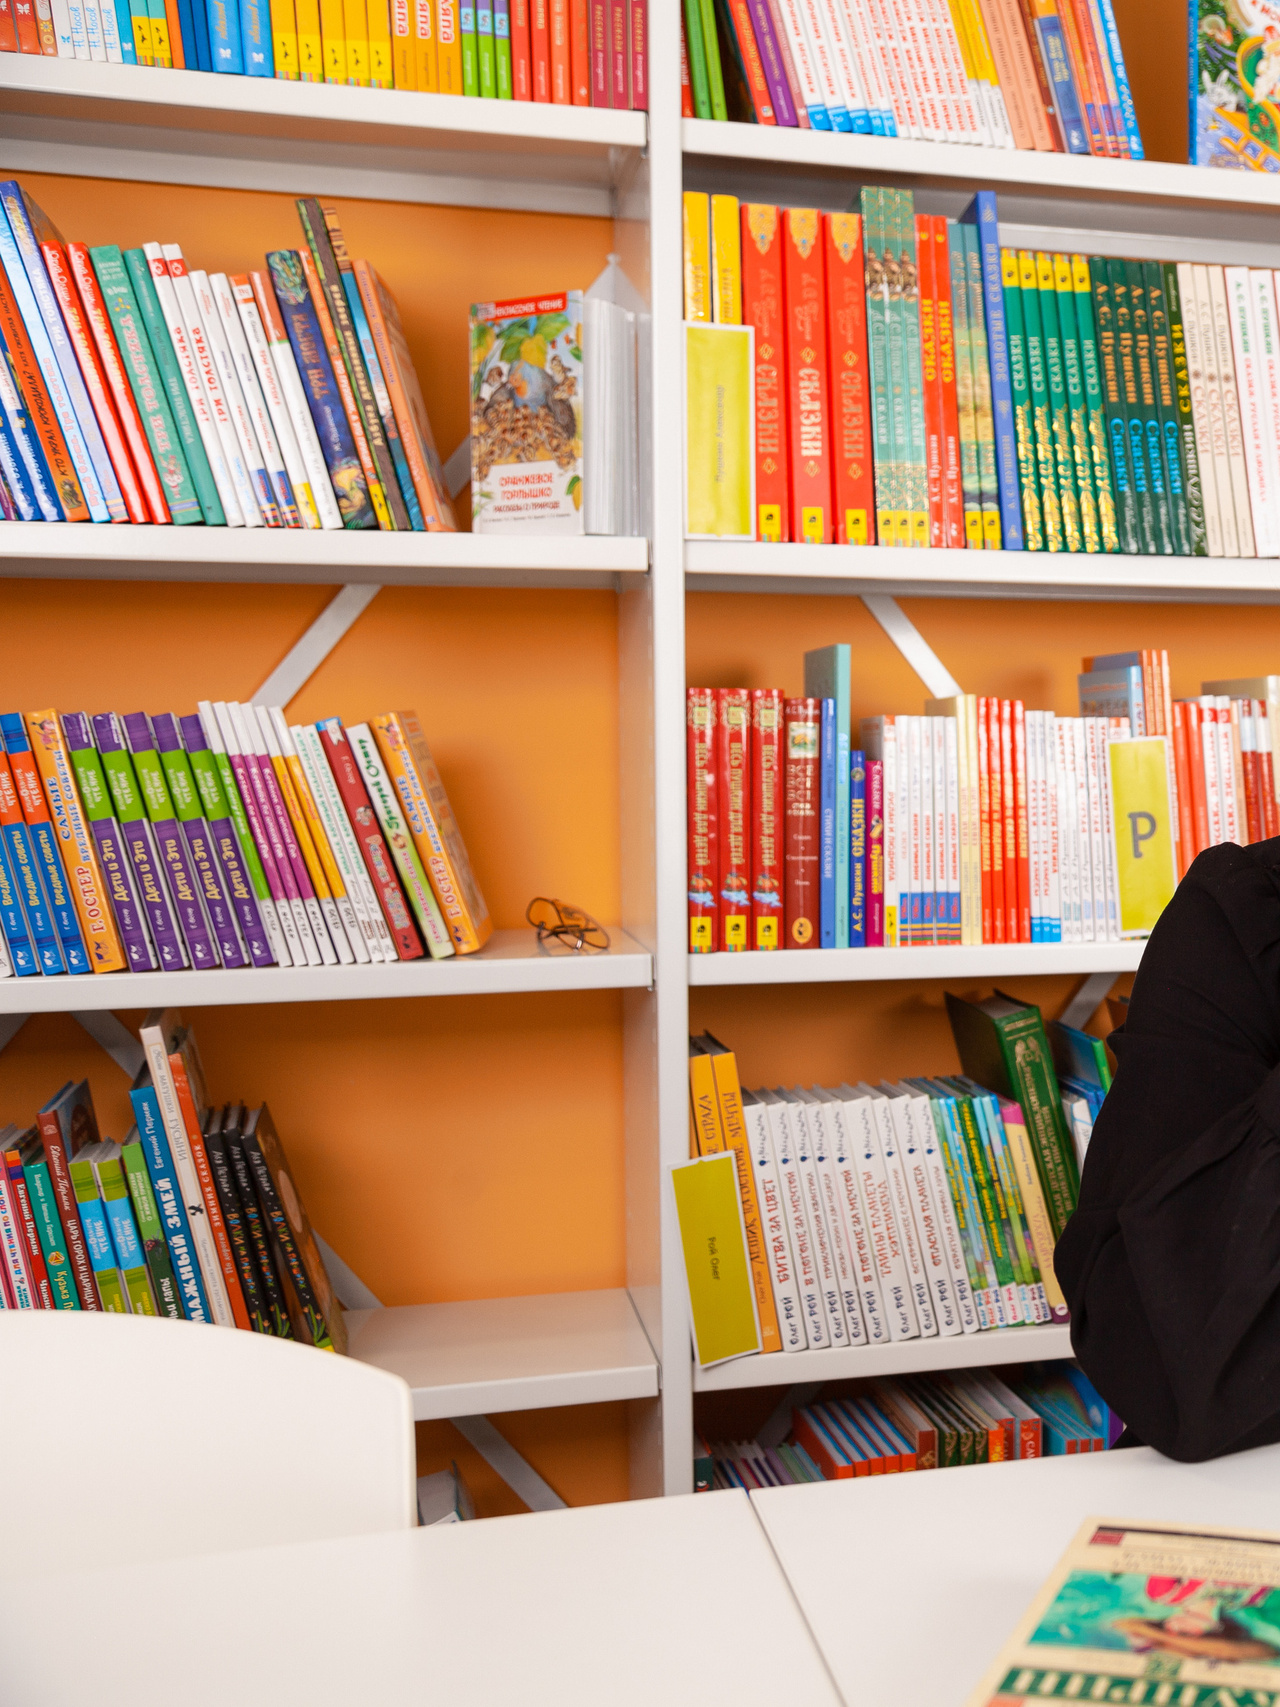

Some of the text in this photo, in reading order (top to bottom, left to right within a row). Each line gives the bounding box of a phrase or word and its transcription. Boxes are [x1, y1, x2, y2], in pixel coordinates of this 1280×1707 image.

[993, 310, 1008, 382] ЗОЛОТЫЕ
[1083, 340, 1100, 396] СКАЗКИ
[1171, 324, 1191, 413] СКАЗКИ
[119, 314, 171, 453] ТРИ ТОЛСТЯКА
[365, 405, 383, 445] Азбука
[799, 368, 822, 456] СКАЗКИ
[46, 429, 61, 455] УКРАЛ
[57, 459, 69, 476] КТО
[26, 771, 43, 805] ЧТЕНИЕ
[46, 777, 71, 840] САМЫЕ
[54, 750, 91, 862] ВРЕДНЫЕ СОВЕТЫ
[151, 770, 167, 803] ЧТЕНИЕ
[178, 771, 192, 803] ЧТЕНИЕ
[206, 771, 220, 803] ЧТЕНИЕ
[358, 739, 400, 830] Григорий Остер
[397, 776, 423, 834] САМЫЕ
[402, 750, 442, 852] ВРЕДНЫЕ СОВЕТЫ
[693, 743, 710, 866] ВЕСЬ ПУШКИН ДЛЯ ДЕТЕЙ
[728, 742, 744, 864] ВЕСЬ ПУШКИН ДЛЯ ДЕТЕЙ
[760, 745, 776, 866] ВЕСЬ ПУШКИН ДЛЯ ДЕТЕЙ
[852, 799, 865, 905] Пушкин СКАЗКИ
[1128, 811, 1158, 860] Р
[11, 831, 40, 906] Вредные советы
[37, 830, 66, 905] Вредные советы
[101, 839, 129, 902] Дети Эти
[132, 840, 162, 902] Дети Эти
[163, 839, 193, 900] Дети Эти
[192, 839, 220, 899] Дети Эти
[221, 838, 249, 898] Дети Эти
[139, 1101, 164, 1169] Евгений Пермяк
[722, 1092, 742, 1138] МЕЧТЫ
[49, 1145, 63, 1176] Евгений
[193, 1144, 222, 1227] ЗИМНИХ СКАЗОК
[56, 1179, 72, 1211] Пермяк
[154, 1178, 182, 1228] ЗМЕЙ
[786, 1172, 801, 1212] МЕЧТОЙ
[914, 1165, 942, 1266] ОПАСНАЯ ПЛАНЕТА
[17, 1183, 39, 1255] Евгений Пермяк
[66, 1219, 80, 1240] ЦАРЬ
[94, 1220, 109, 1252] ЧТЕНИЕ
[121, 1219, 137, 1250] ЧТЕНИЕ
[226, 1213, 243, 1245] ВОЛКИ
[245, 1207, 264, 1238] ВОЛКИ
[270, 1211, 290, 1242] ВОЛКИ
[761, 1179, 789, 1283] БИТВА ЗА ЦВЕТ
[793, 1214, 803, 1229] ЗА
[843, 1170, 872, 1272] ПОГОНЕ ЗА МЕЧТОЙ
[863, 1171, 892, 1277] ТАЙНЫ ПЛАНЕТЫ
[72, 1240, 86, 1265] ГОРОХ
[54, 1271, 70, 1299] Кузька
[80, 1272, 94, 1302] ЦАРИЦА
[916, 1283, 932, 1330] Олег РОЙ
[937, 1280, 954, 1326] Олег РОЙ
[954, 1279, 975, 1326] Олег РОЙ
[872, 1317, 882, 1338] Олег
[899, 1311, 910, 1333] Олег
